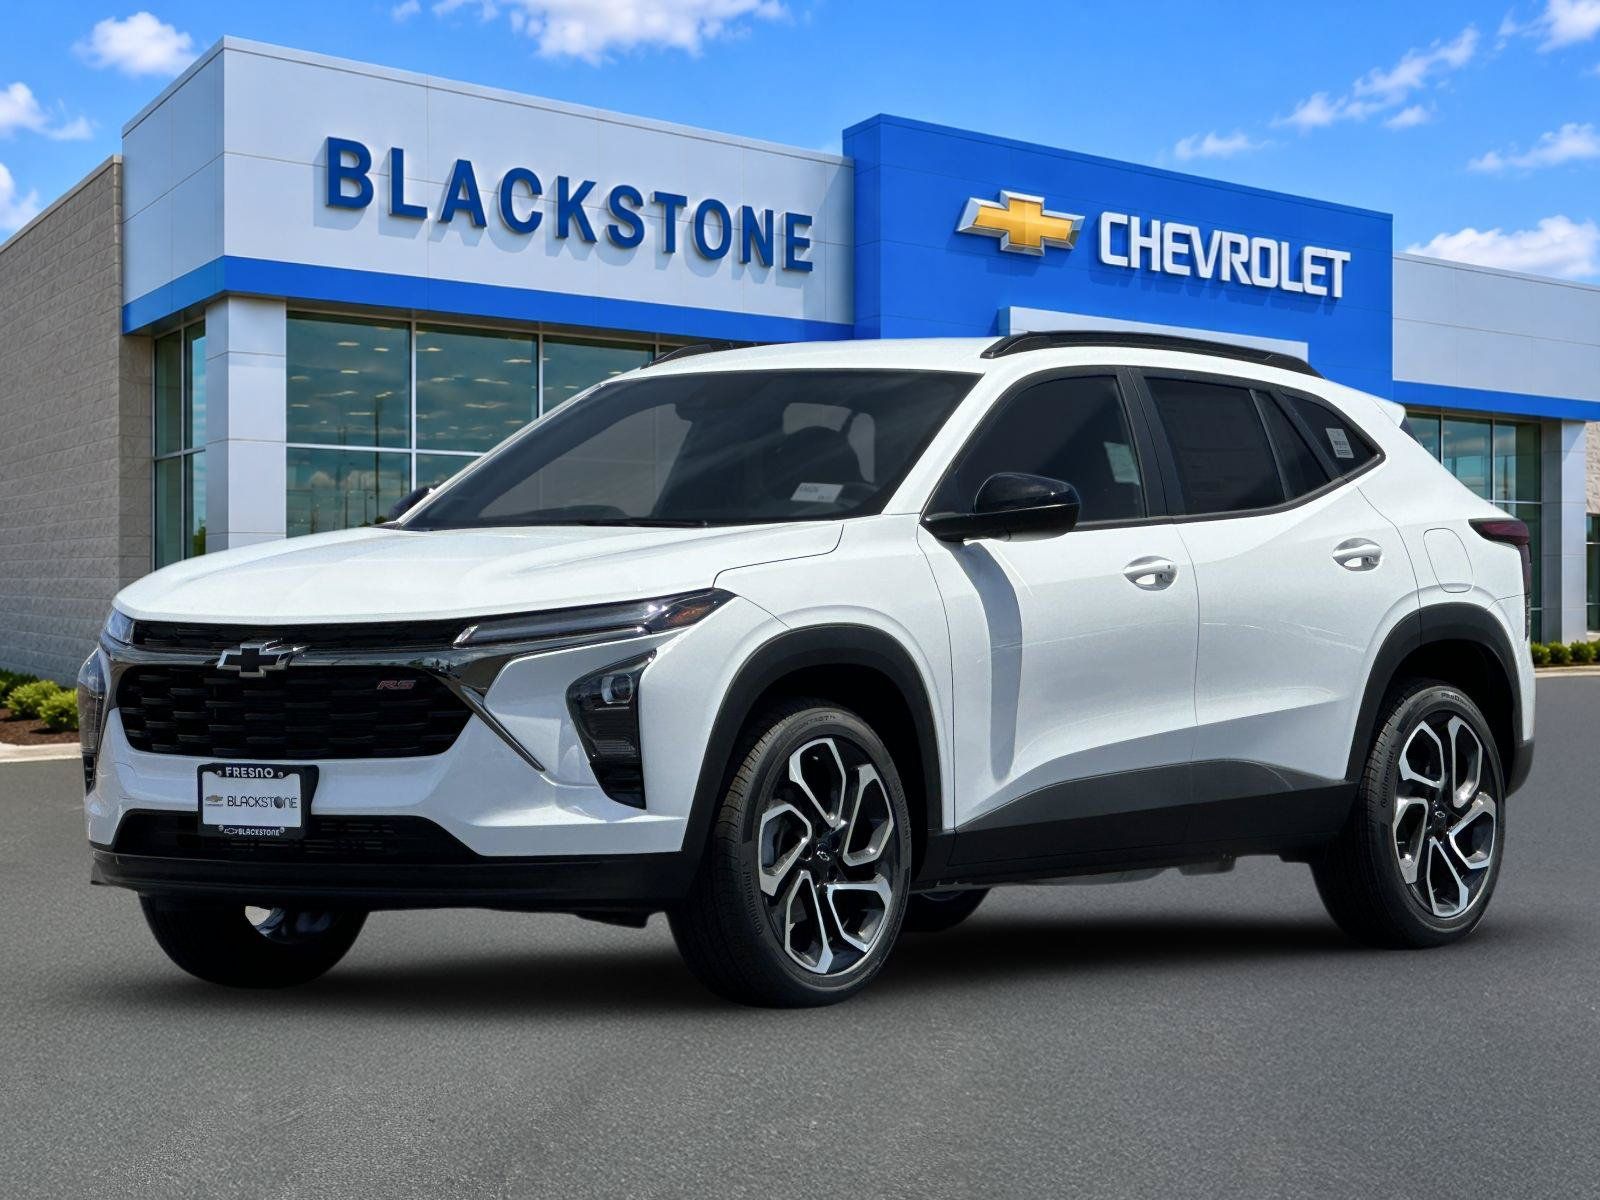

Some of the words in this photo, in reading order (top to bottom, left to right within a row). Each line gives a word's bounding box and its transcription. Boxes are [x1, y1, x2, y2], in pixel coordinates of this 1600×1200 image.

[324, 136, 813, 272] BLACKSTONE
[1099, 211, 1351, 298] CHEVROLET
[376, 680, 416, 690] RS
[225, 767, 274, 778] FRESNO
[227, 795, 298, 809] BLACKSTONE
[238, 827, 280, 837] BLACKSTONE
